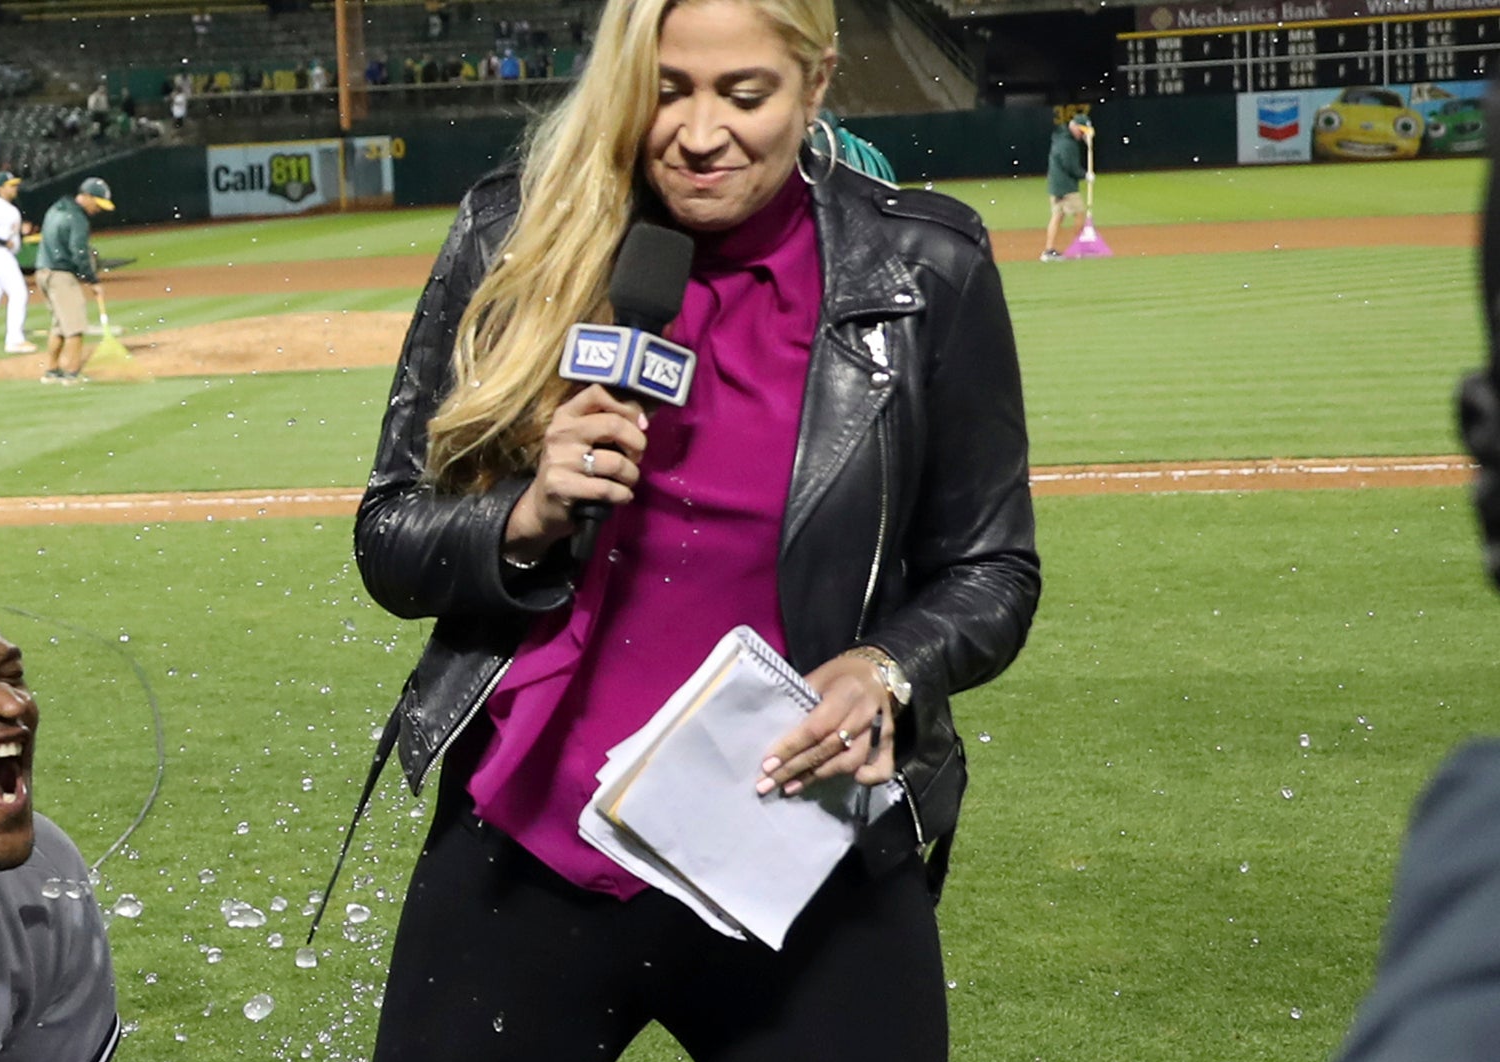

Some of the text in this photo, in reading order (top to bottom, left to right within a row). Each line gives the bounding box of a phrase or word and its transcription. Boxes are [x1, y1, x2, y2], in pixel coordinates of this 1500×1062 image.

[1177, 6, 1277, 28] Mechanics
[1281, 1, 1328, 20] Bank
[214, 154, 311, 192] Call 811
[575, 338, 619, 369] YES
[641, 350, 683, 390] YES
